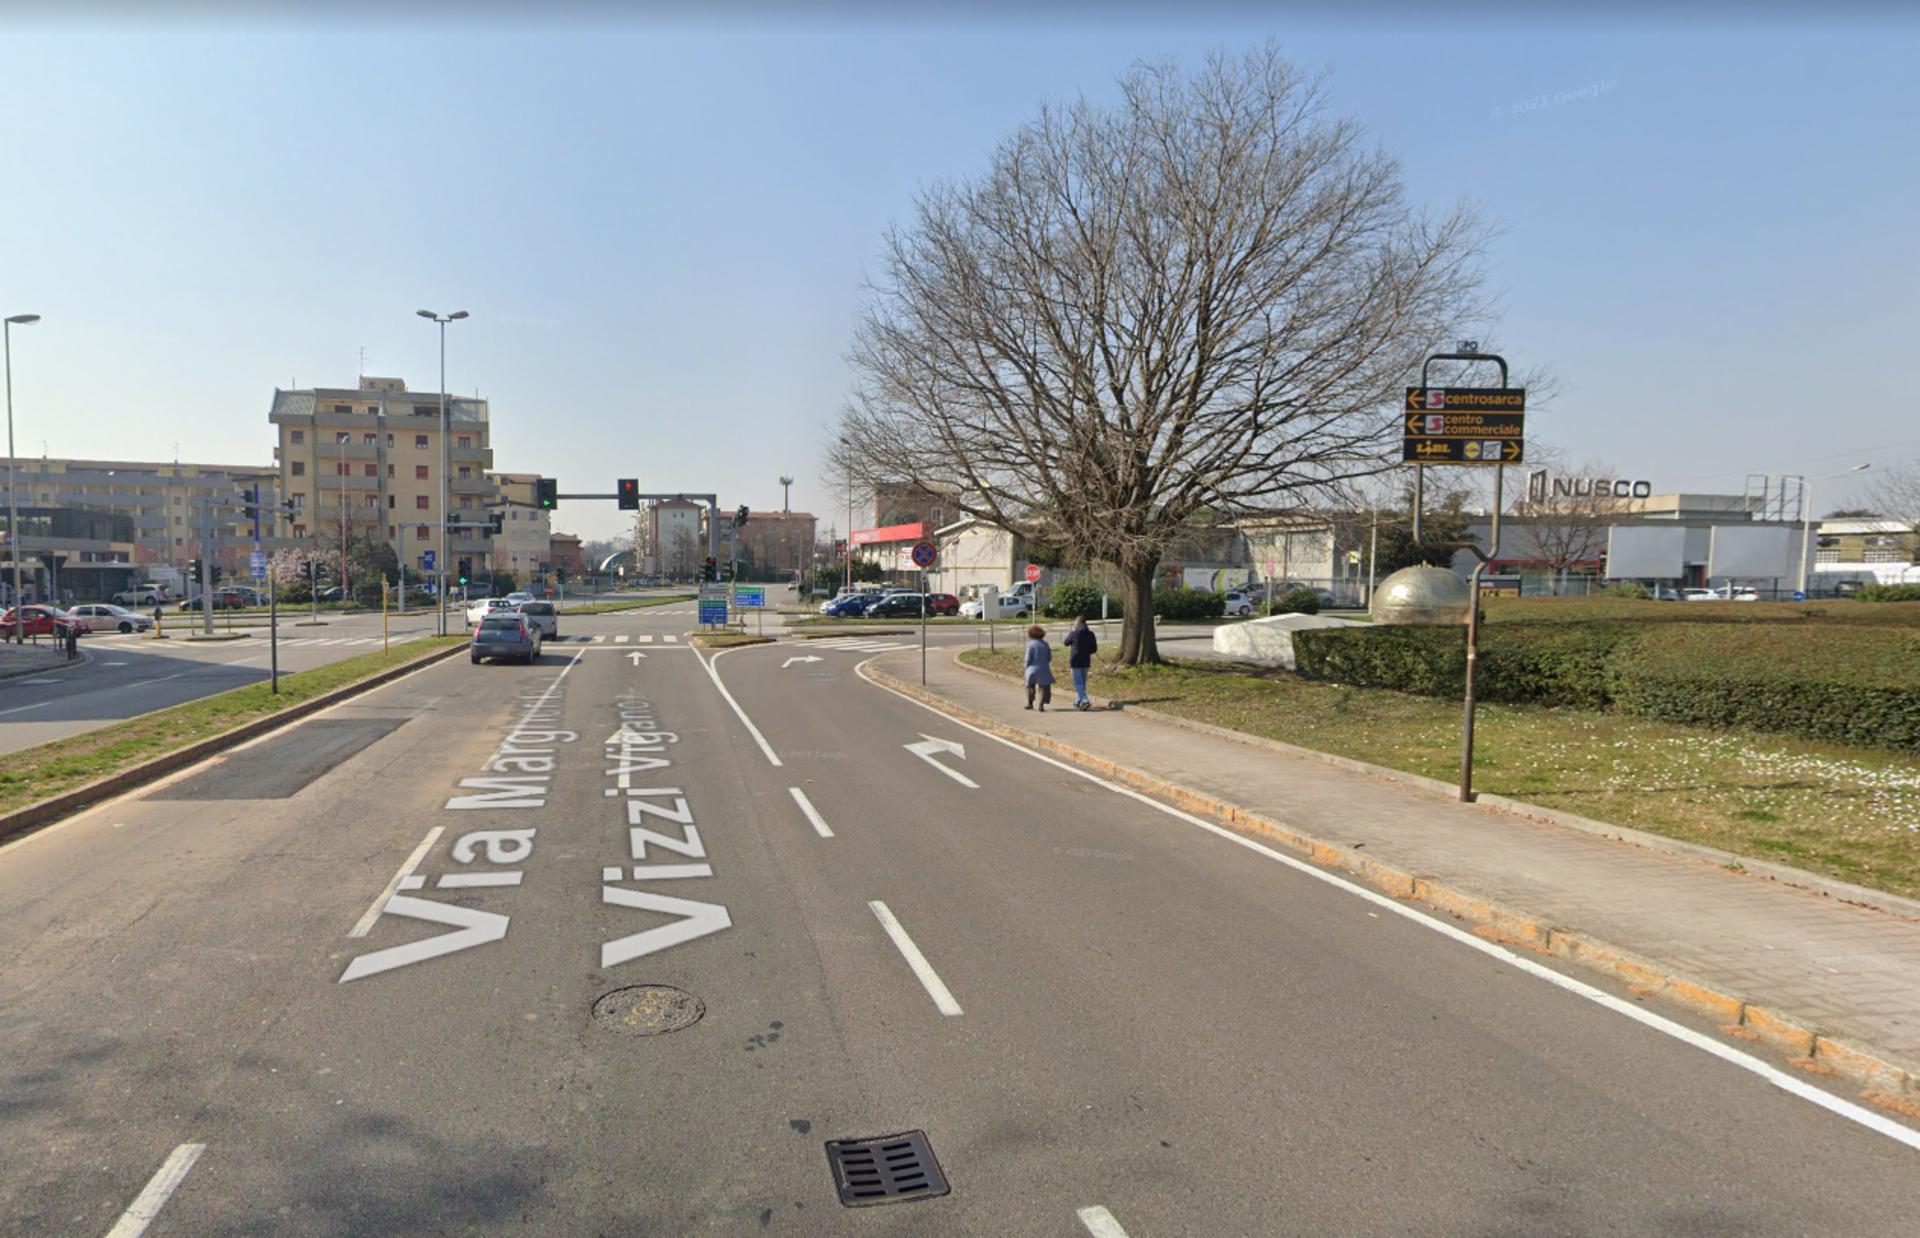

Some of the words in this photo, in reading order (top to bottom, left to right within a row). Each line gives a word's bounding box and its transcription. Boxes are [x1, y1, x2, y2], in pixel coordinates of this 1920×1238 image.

[1444, 393, 1522, 406] centrosarca
[1444, 414, 1484, 424] centro
[1444, 424, 1521, 435] commerciale
[1552, 477, 1651, 498] NUSCO
